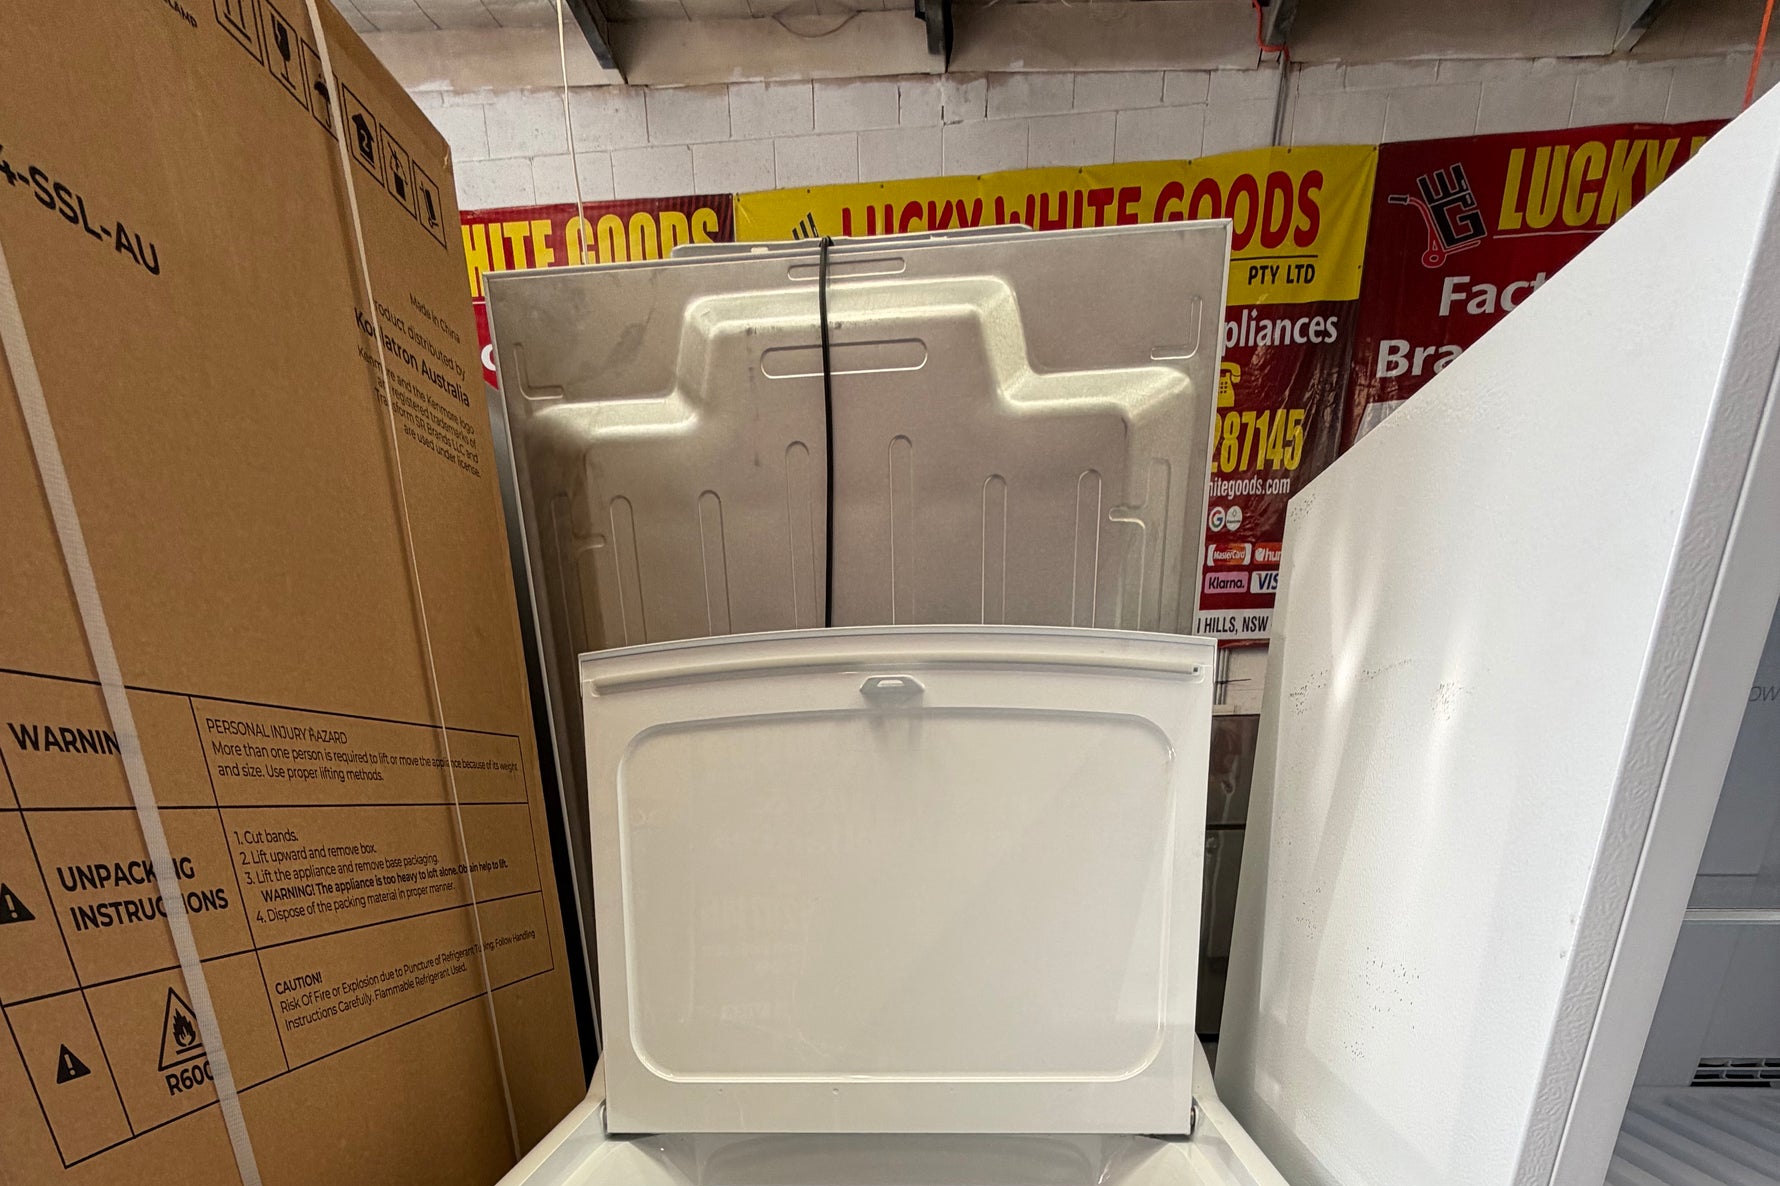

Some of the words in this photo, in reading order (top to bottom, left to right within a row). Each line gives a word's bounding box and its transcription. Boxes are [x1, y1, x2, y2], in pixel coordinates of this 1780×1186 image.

[1497, 137, 1681, 230] LUCKY
[1154, 170, 1323, 251] GOODS
[1248, 264, 1279, 286] PTY
[1286, 263, 1315, 285] LTD
[409, 292, 431, 321] Made
[440, 319, 461, 345] China
[373, 300, 406, 335] roduct
[407, 324, 454, 371] distributed
[456, 365, 465, 382] by
[357, 345, 395, 382] Kenmre
[397, 375, 412, 394] and
[413, 385, 426, 403] the
[426, 393, 460, 425] Kenmore
[460, 418, 475, 435] logo
[391, 386, 429, 415] registered
[421, 359, 470, 408] Australia
[375, 386, 415, 424] Trasform
[426, 422, 451, 447] Brands
[451, 439, 465, 456] LLC
[466, 448, 479, 464] and
[404, 424, 416, 440] are
[417, 433, 435, 452] used
[437, 443, 456, 464] under
[1258, 573, 1279, 590] VIS
[1204, 617, 1238, 634] HILLS,
[1241, 615, 1269, 633] NSW
[7, 722, 122, 755] WARNIN
[206, 717, 270, 738] PERSONAL
[271, 724, 307, 741] INJURY
[212, 740, 242, 757] More
[243, 743, 269, 759] than
[271, 747, 290, 760] one
[292, 749, 323, 763] person
[325, 748, 333, 762] is
[334, 751, 368, 766] required
[369, 753, 378, 765] to
[378, 752, 389, 765] lift
[390, 756, 399, 766] or
[399, 756, 419, 767] move
[420, 755, 431, 767] the
[218, 763, 240, 777] and
[241, 763, 265, 778] size.
[265, 764, 285, 778] Use
[287, 767, 318, 782] proper
[319, 766, 344, 783] lifting
[346, 768, 384, 782] methods.
[234, 830, 244, 846] 1.
[244, 830, 264, 845] Cut
[265, 827, 299, 843] bands.
[240, 851, 250, 866] 2.
[250, 849, 269, 865] Lift
[269, 846, 308, 864] upward
[308, 845, 326, 859] and
[327, 845, 360, 858] remove
[360, 842, 377, 854] box.
[57, 856, 195, 892] UNPACKG
[245, 871, 256, 885] 3.
[256, 868, 273, 884] Lift
[274, 868, 291, 882] the
[293, 864, 337, 881] appliance
[337, 860, 354, 875] and
[355, 859, 384, 873] remove
[385, 857, 402, 869] base
[261, 883, 315, 903] WARNING!
[316, 882, 333, 896] The
[335, 878, 374, 894] appliance
[375, 874, 382, 887] is
[383, 875, 397, 886] too
[397, 872, 418, 885] heavy
[418, 870, 427, 880] to
[427, 868, 439, 880] loft
[439, 866, 458, 877] alone.
[458, 863, 478, 875] Obain
[479, 862, 492, 873] help
[492, 861, 499, 870] to
[69, 888, 228, 931] INSTRUCIONS
[256, 911, 267, 924] 4.
[266, 906, 305, 923] Dispose
[306, 901, 316, 915] of
[316, 901, 332, 914] the
[333, 895, 367, 912] packing
[367, 889, 398, 905] material
[398, 887, 406, 899] in
[406, 885, 429, 899] proper
[275, 971, 323, 996] CAUTION!
[280, 996, 301, 1014] Risk
[301, 991, 314, 1007] Of
[313, 988, 331, 1004] Fire
[332, 985, 341, 997] or
[341, 975, 379, 995] Explosion
[380, 970, 395, 983] due
[395, 968, 403, 978] to
[403, 958, 435, 975] Puncture
[435, 954, 442, 967] of
[441, 945, 474, 964] Refrigerant
[285, 1005, 338, 1031] Instructions
[338, 992, 375, 1013] Carefully.
[374, 977, 415, 1000] Flammable
[414, 968, 451, 988] Refrigerant
[165, 1060, 215, 1096] R600
